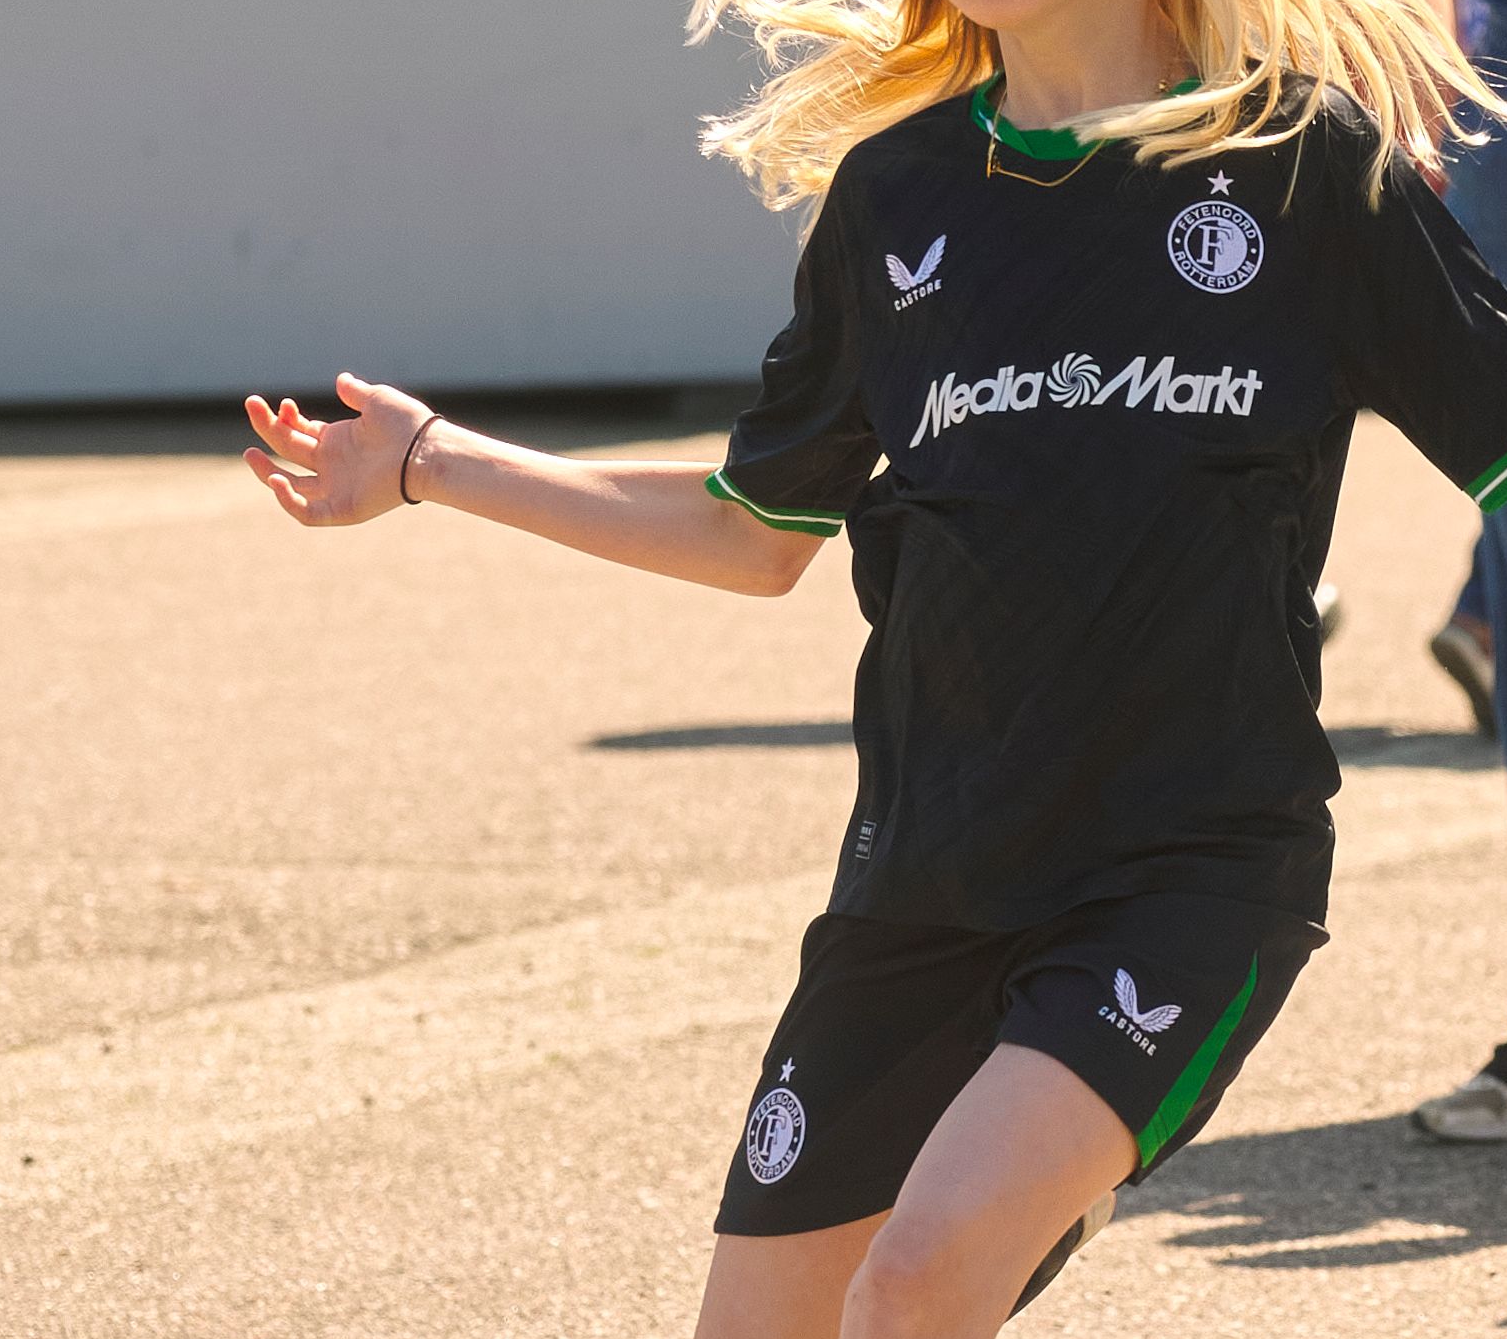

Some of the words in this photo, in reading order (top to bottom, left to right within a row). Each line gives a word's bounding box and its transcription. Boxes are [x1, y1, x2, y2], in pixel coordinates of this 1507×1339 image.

[1177, 205, 1258, 240] FEYENOORD
[1174, 250, 1256, 289] ROTTERDAM
[893, 278, 942, 312] CASTORE
[908, 363, 1045, 450] Media
[1090, 355, 1264, 418] Markt
[1097, 1005, 1158, 1057] CASTORE
